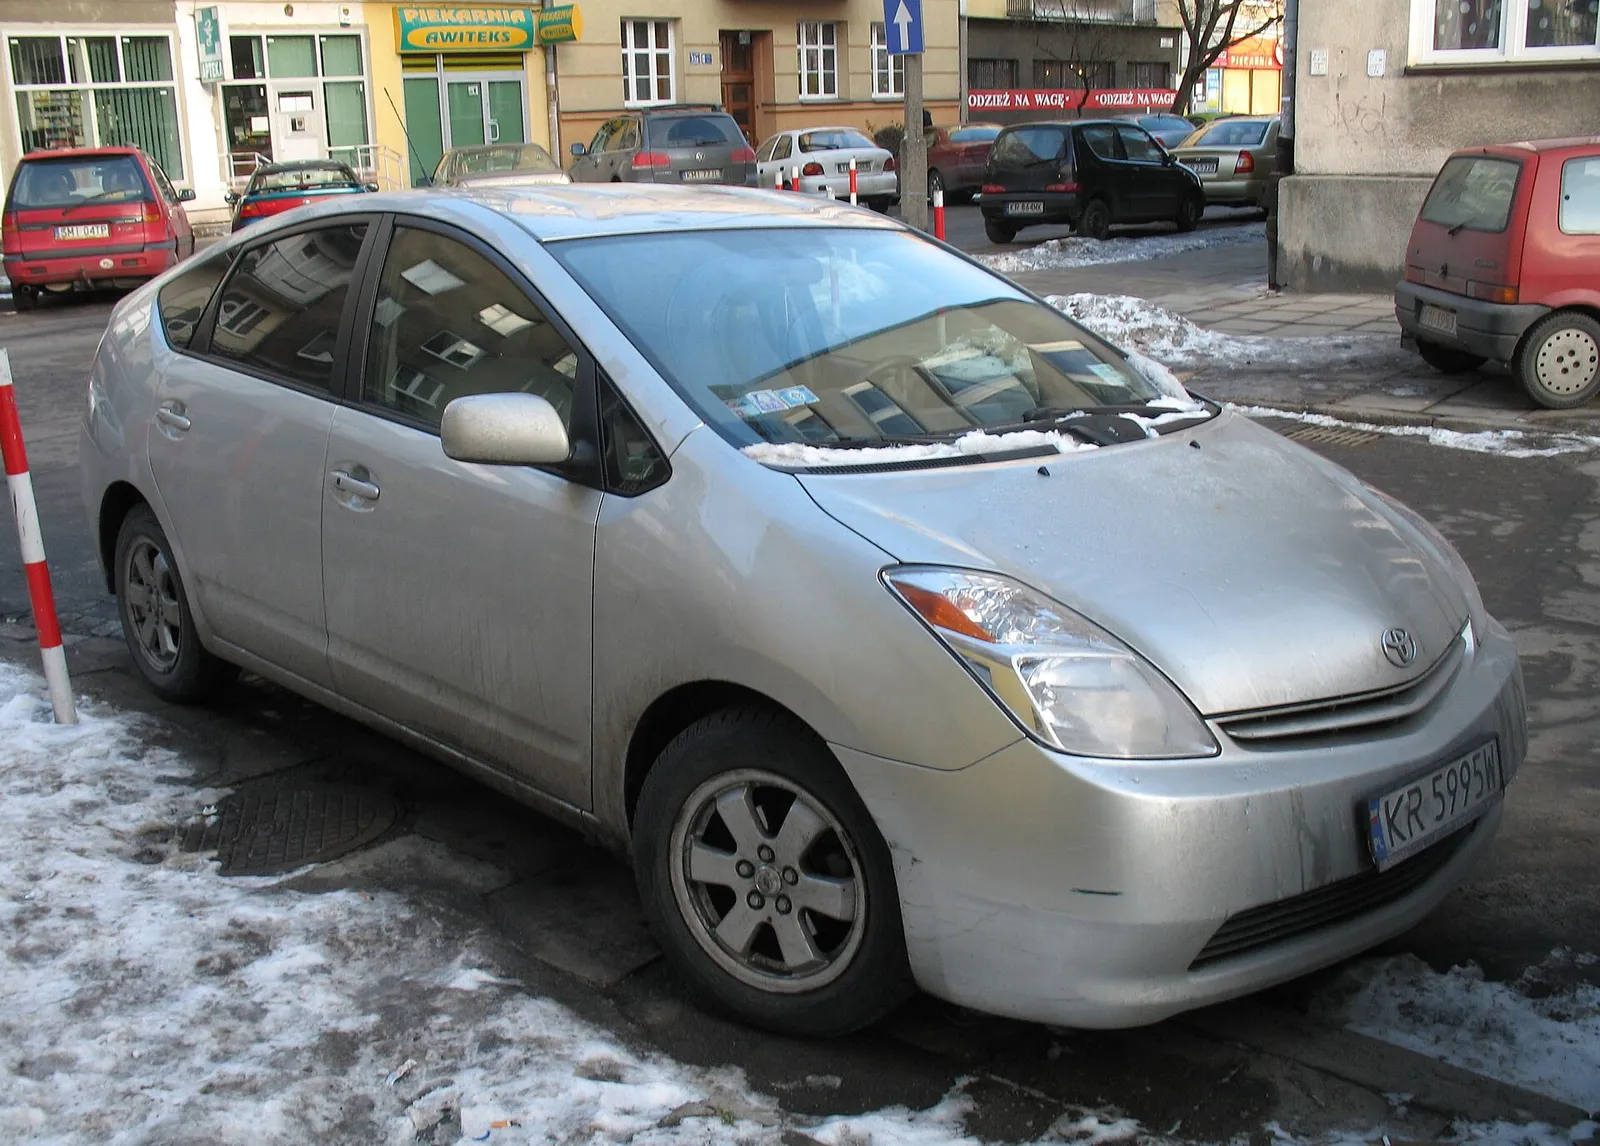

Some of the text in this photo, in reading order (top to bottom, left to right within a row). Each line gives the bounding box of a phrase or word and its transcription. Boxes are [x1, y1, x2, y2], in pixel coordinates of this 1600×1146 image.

[403, 8, 526, 23] PIEKARNIA
[425, 31, 511, 44] AWITEKS
[201, 61, 224, 79] APTEKA
[968, 91, 1065, 109] ODZIEŻ NA WAGĘ
[1099, 91, 1135, 105] ODZIEŻ
[1137, 93, 1150, 105] NA
[1384, 786, 1426, 847] KR
[1431, 744, 1497, 821] 5995W
[1373, 838, 1384, 851] PL
